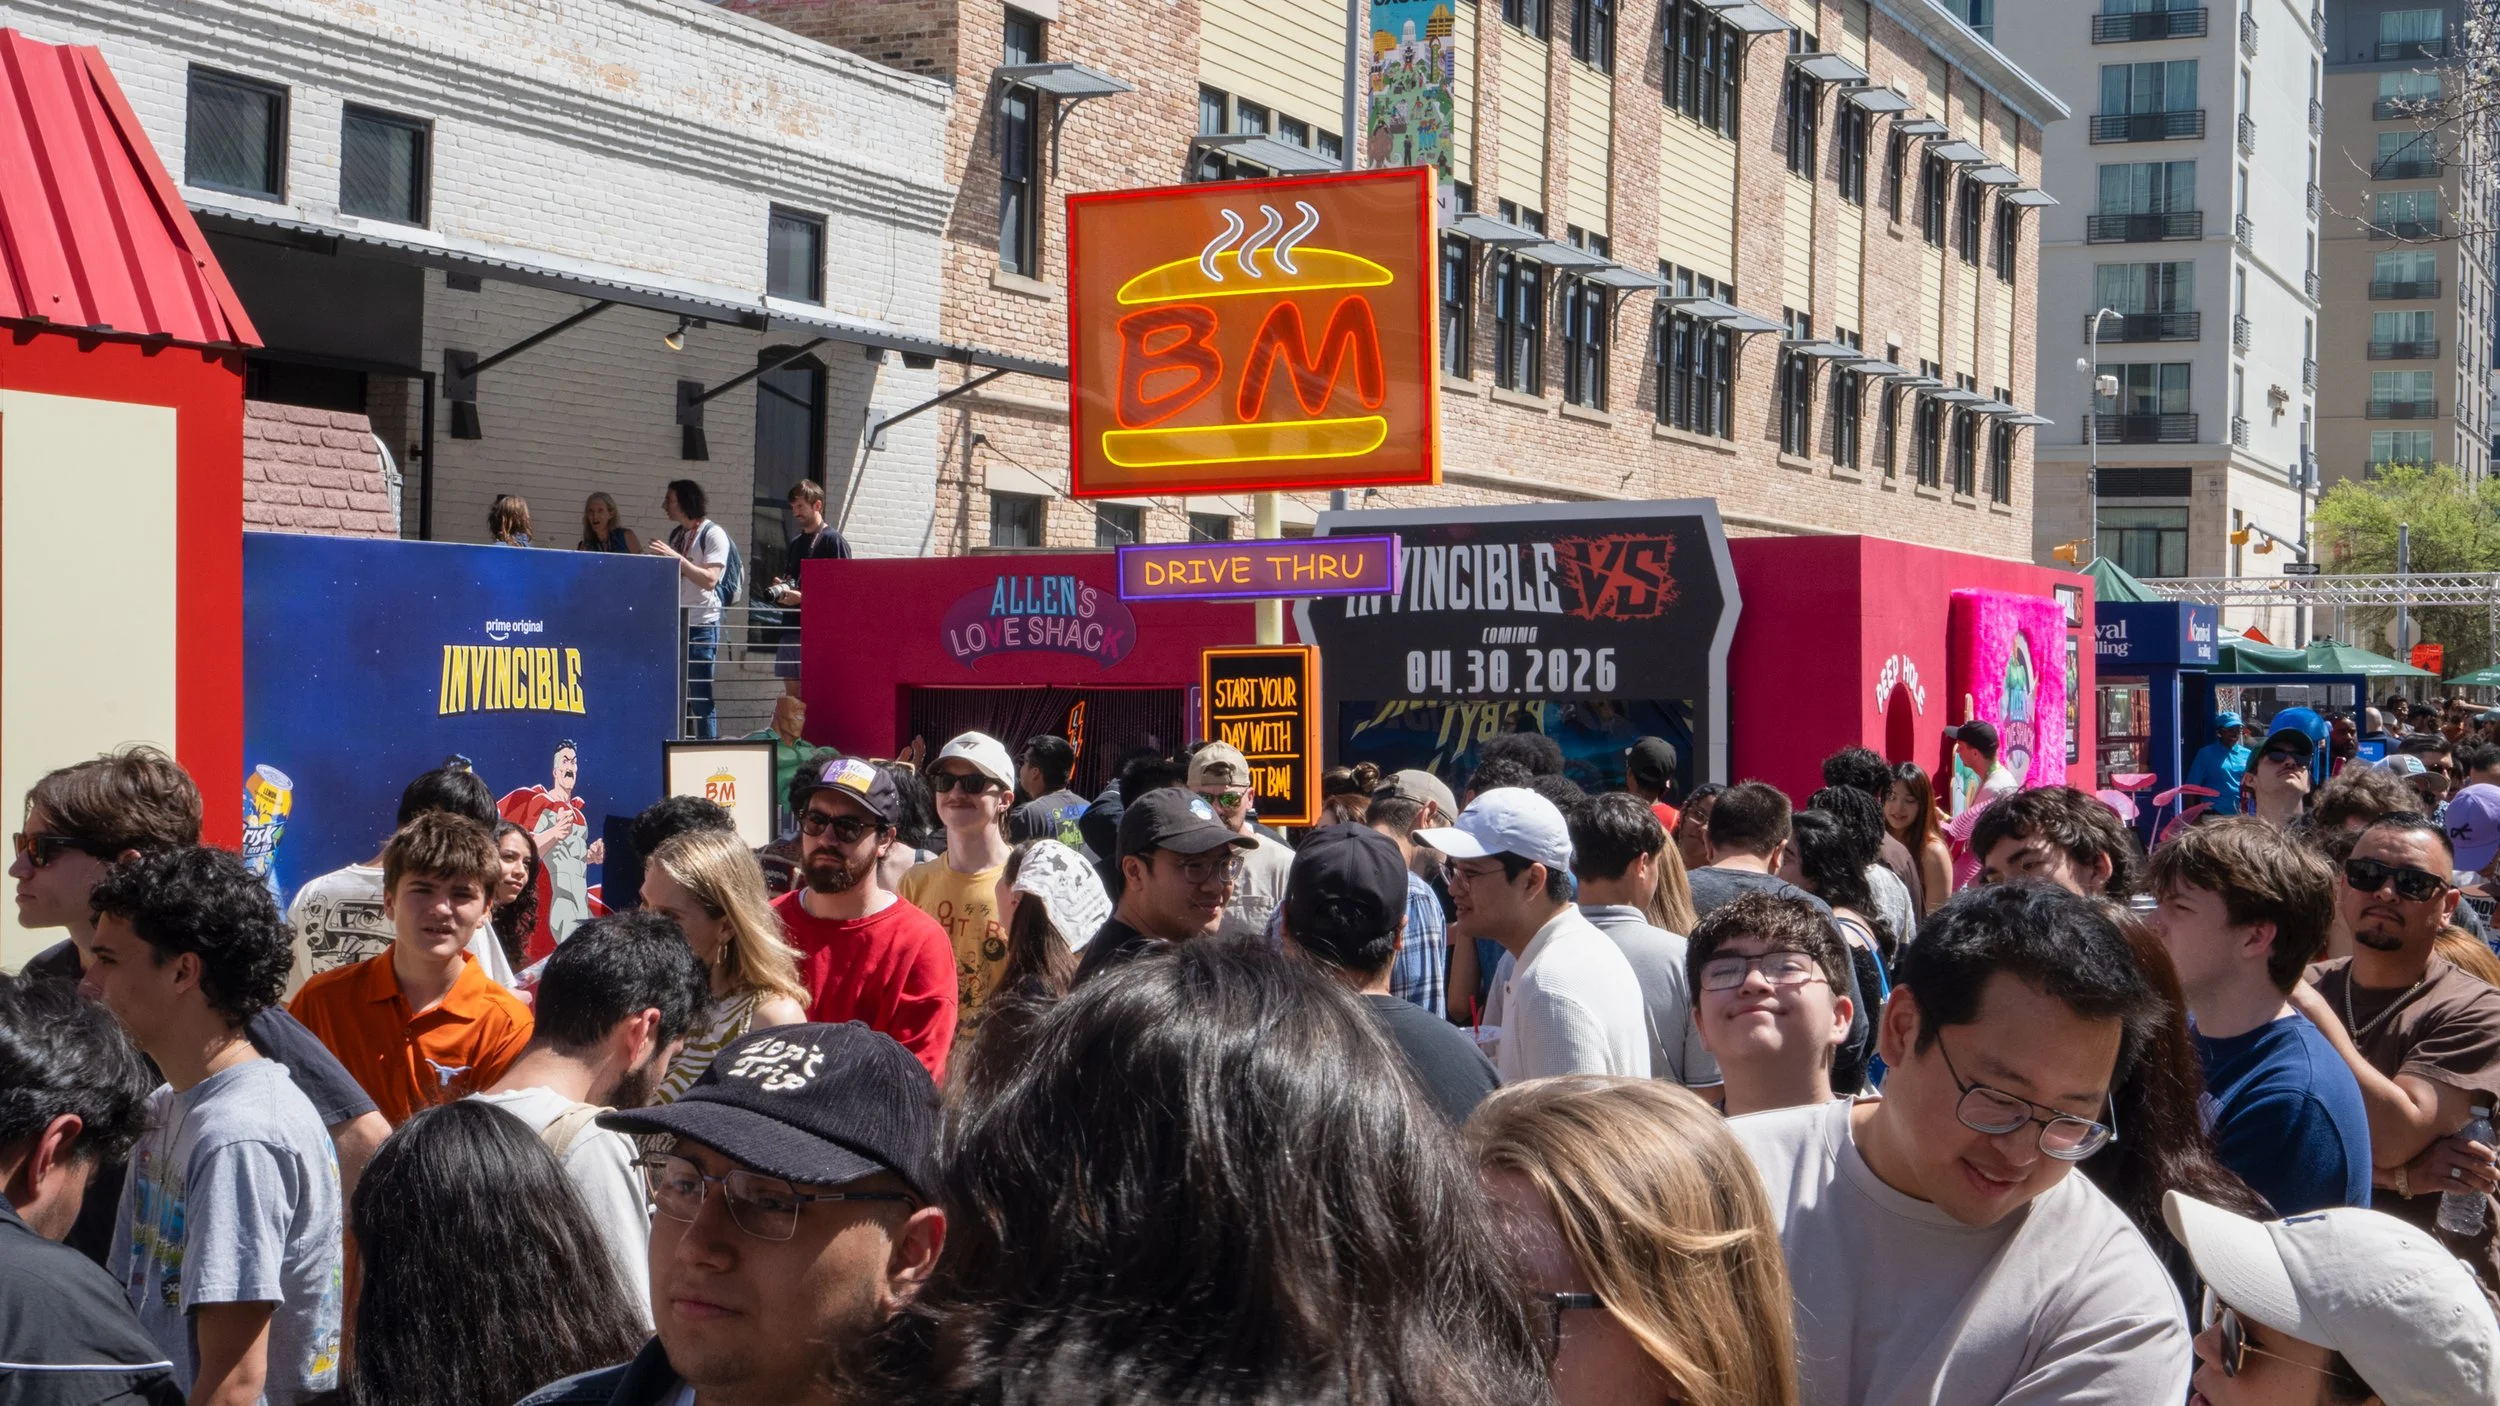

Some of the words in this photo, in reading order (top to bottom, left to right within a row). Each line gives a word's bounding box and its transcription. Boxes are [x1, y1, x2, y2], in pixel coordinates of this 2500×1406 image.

[1116, 294, 1385, 430] BM
[1145, 557, 1252, 586] DRIVE
[1266, 553, 1364, 581] THRU
[1345, 543, 1564, 618] VINCIBLE
[990, 576, 1097, 618] ALLEN'S
[486, 619, 511, 634] prime
[513, 619, 544, 635] original
[950, 617, 1021, 657] LOVE
[1028, 616, 1125, 659] SHACK
[1482, 626, 1538, 644] COMING
[2095, 620, 2128, 639] val
[439, 644, 587, 717] INVINCIBLE
[1406, 648, 1617, 694] 04.30.2026
[1876, 654, 1899, 714] PEEP
[1902, 654, 1926, 716] HOLE
[1215, 677, 1258, 708] START
[1259, 676, 1297, 708] YOUR
[1221, 721, 1248, 751] DAY
[1250, 720, 1291, 752] WITH
[705, 782, 736, 801] BM
[1249, 767, 1266, 796] OT
[1267, 765, 1291, 800] BM!
[243, 825, 278, 846] risk
